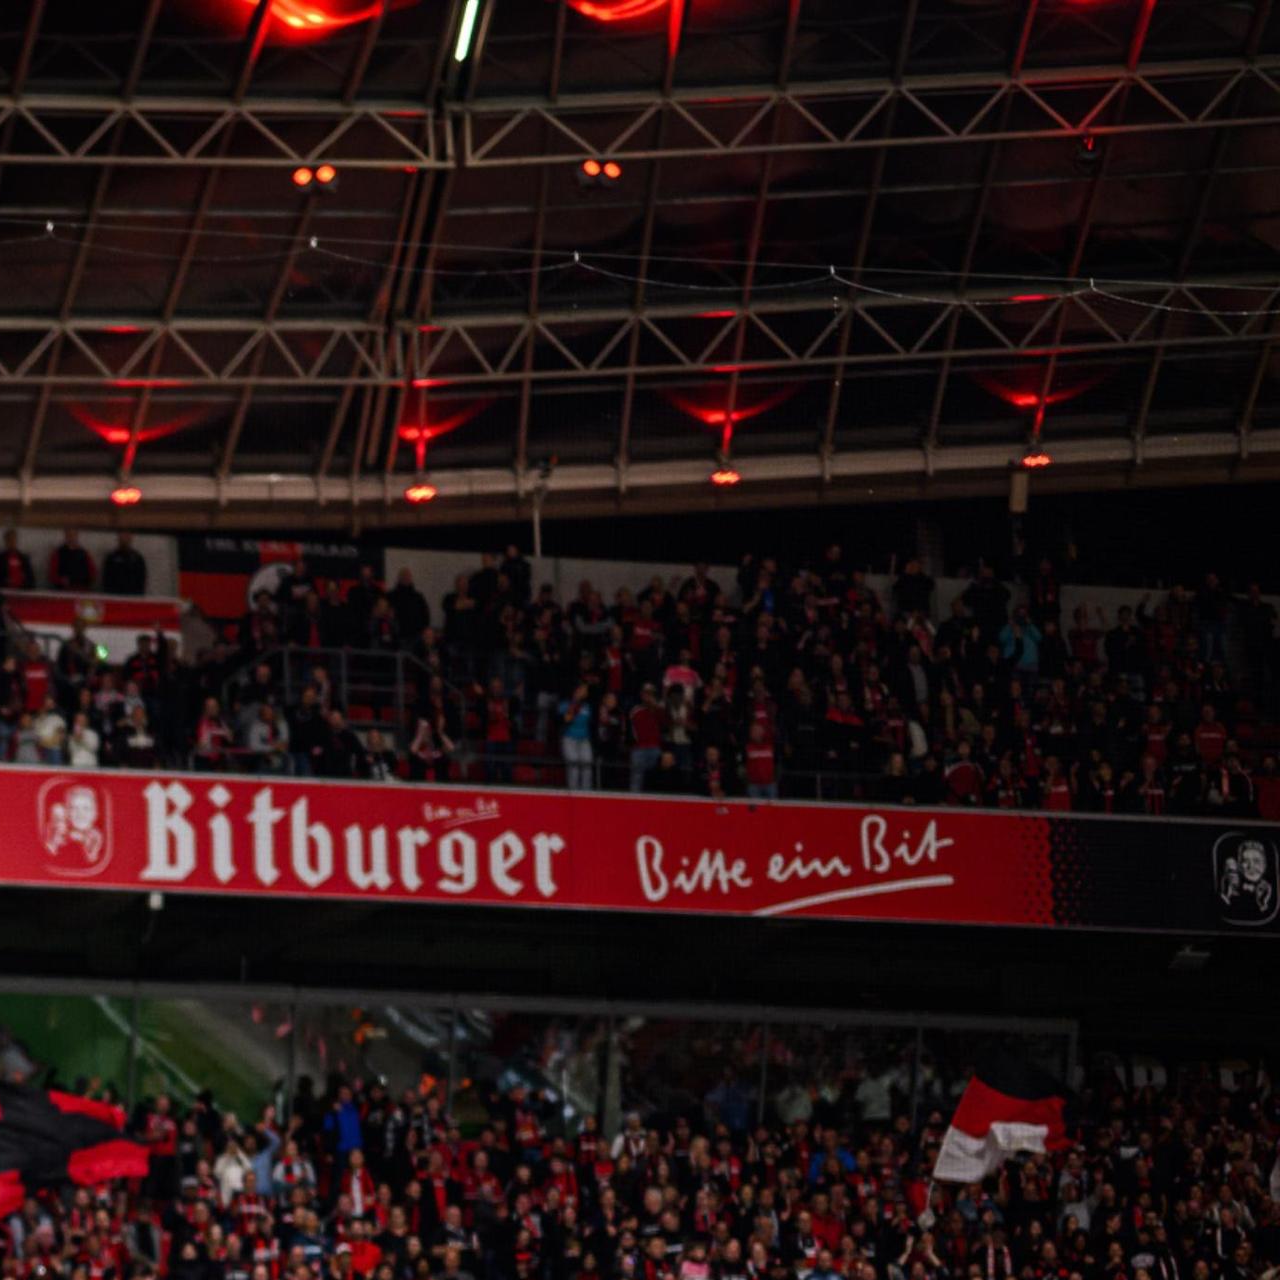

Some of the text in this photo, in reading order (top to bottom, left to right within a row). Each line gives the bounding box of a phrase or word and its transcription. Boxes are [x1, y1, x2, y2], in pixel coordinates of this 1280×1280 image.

[140, 780, 565, 897] Bitburger
[635, 814, 954, 901] Bitte ein Bit
